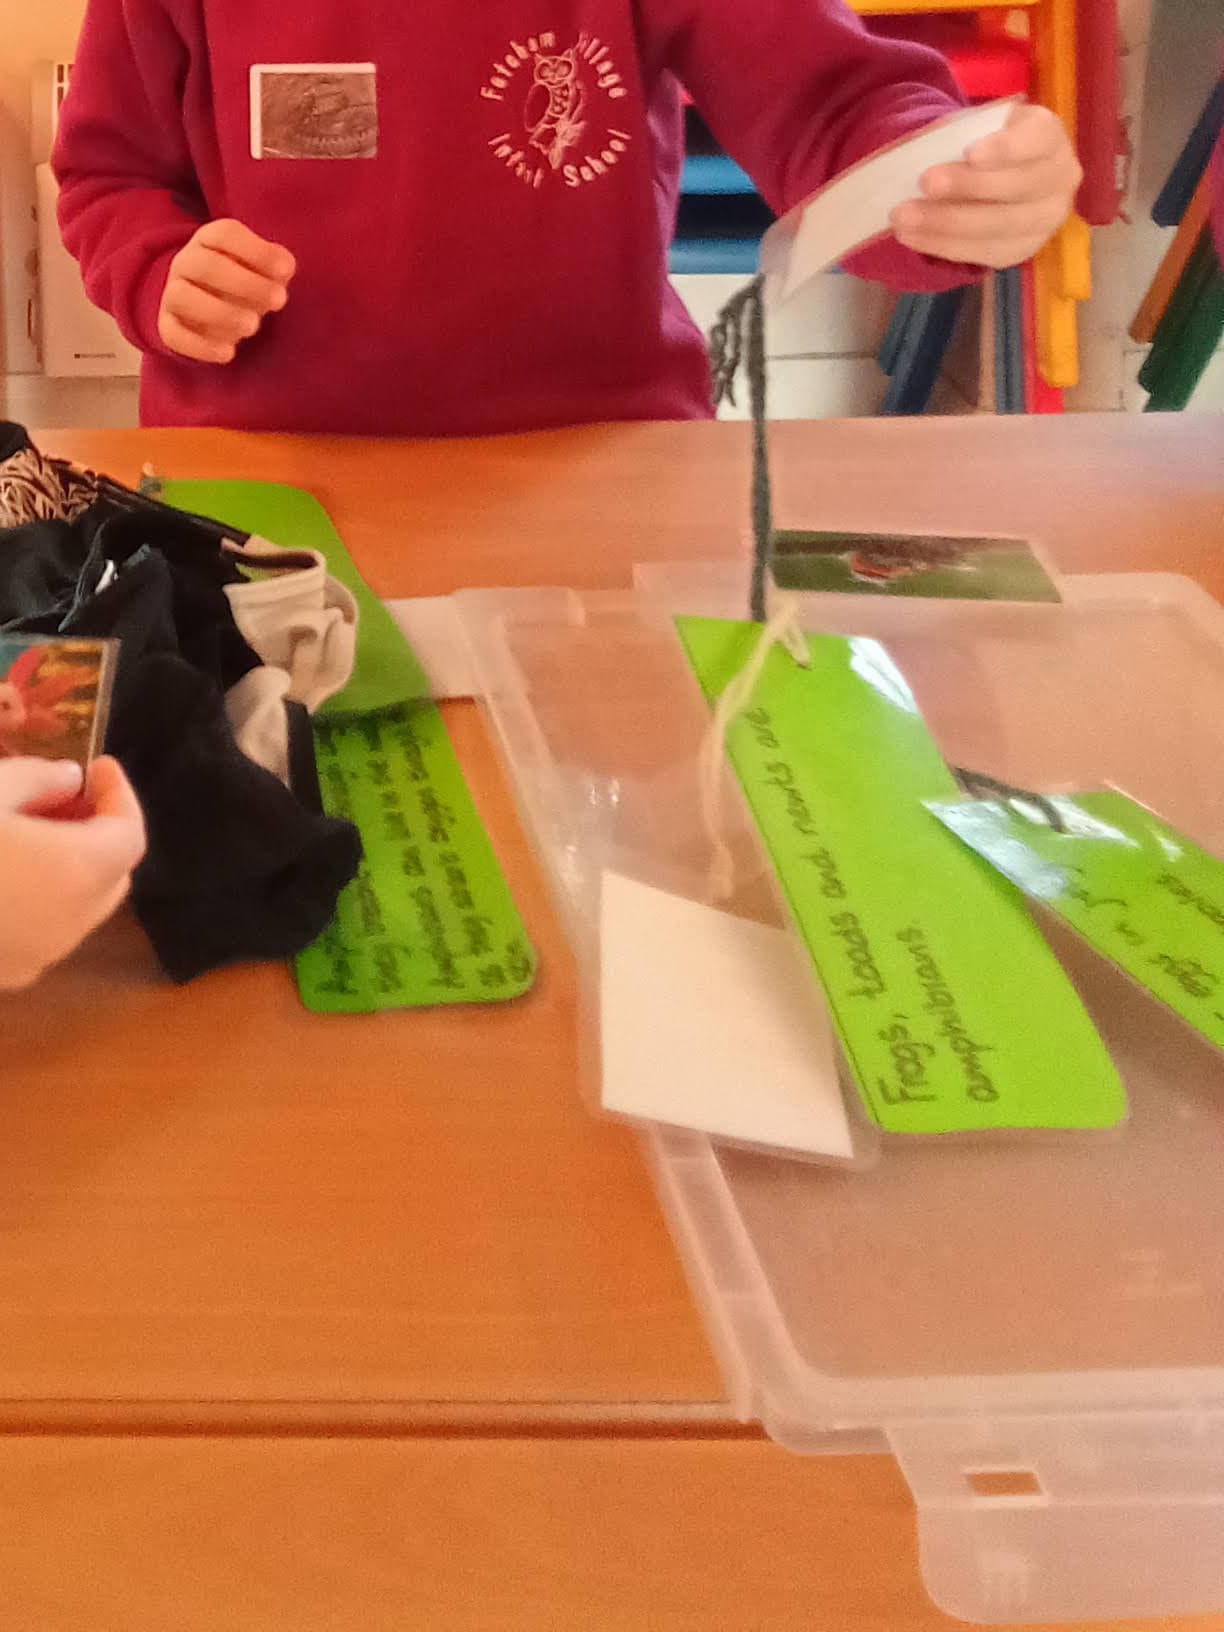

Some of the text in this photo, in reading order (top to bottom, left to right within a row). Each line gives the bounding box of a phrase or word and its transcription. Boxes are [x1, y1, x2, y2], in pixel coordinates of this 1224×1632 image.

[563, 128, 632, 188] School
[763, 761, 818, 840] newts
[802, 847, 846, 899] and
[829, 911, 886, 999] toads
